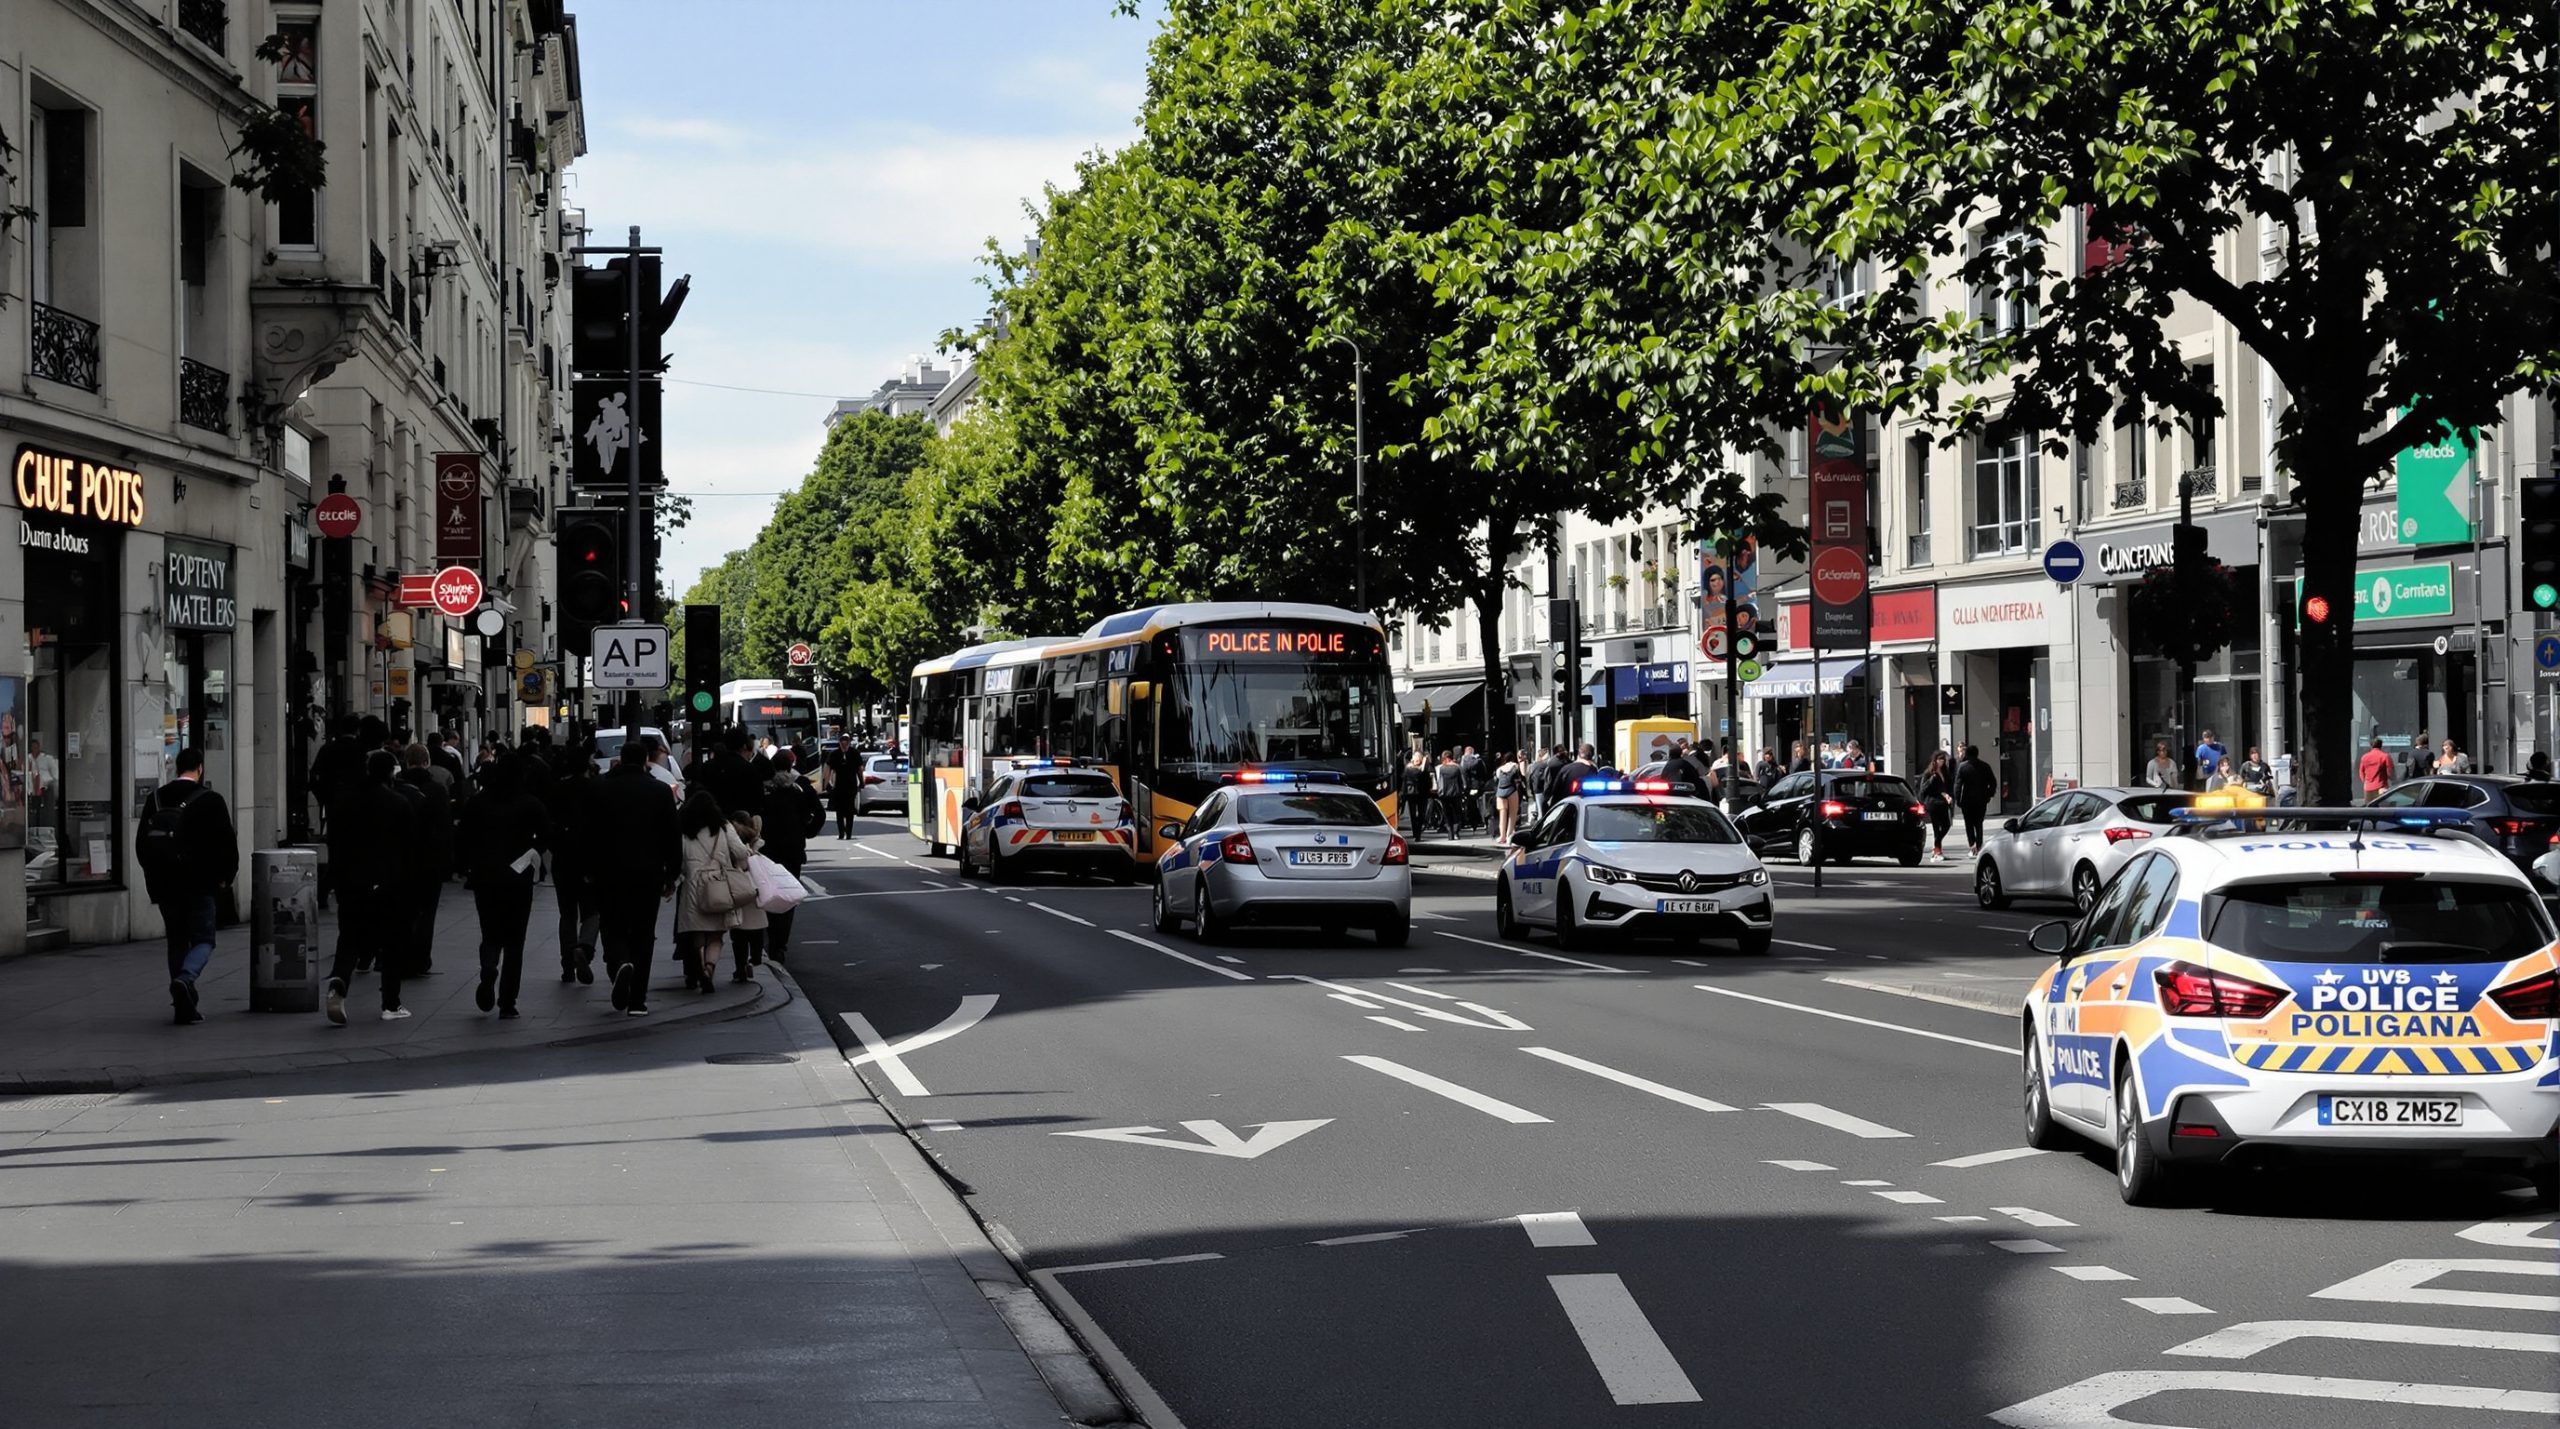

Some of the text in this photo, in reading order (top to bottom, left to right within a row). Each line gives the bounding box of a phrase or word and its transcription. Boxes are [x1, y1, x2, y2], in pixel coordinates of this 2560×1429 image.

[81, 463, 144, 527] POITS
[602, 638, 656, 667] AP
[1209, 633, 1345, 652] POLICE IN POLIE
[2240, 840, 2439, 852] POLCE
[2362, 969, 2411, 985] UVS
[2312, 985, 2460, 1012] POLICE
[2292, 1014, 2481, 1037] POLIGANA
[2057, 1046, 2104, 1080] POLICE
[2396, 1101, 2459, 1122] ZM52
